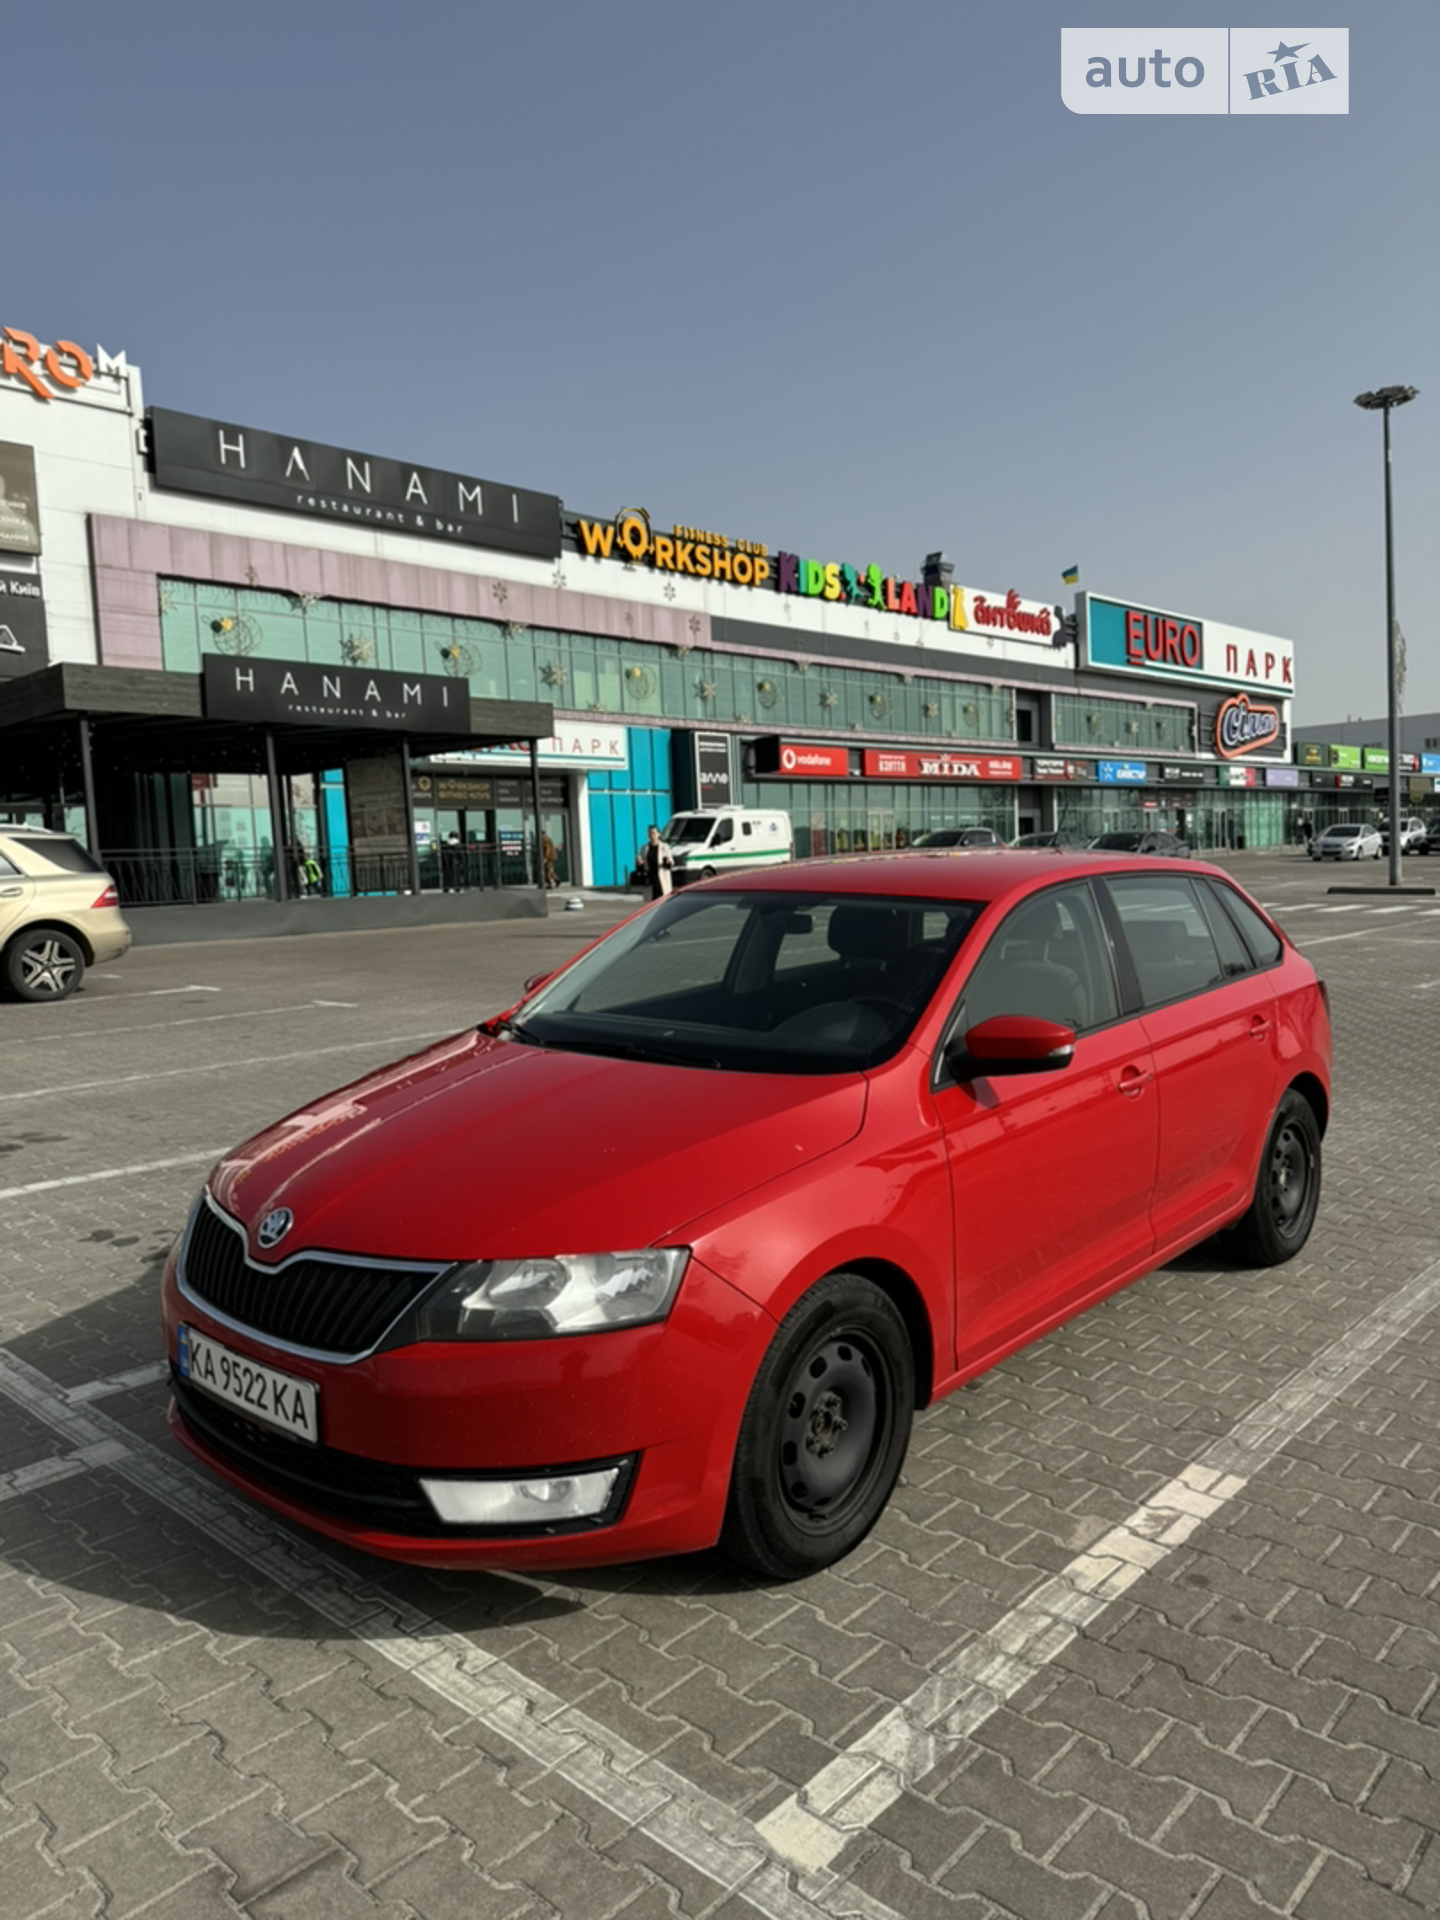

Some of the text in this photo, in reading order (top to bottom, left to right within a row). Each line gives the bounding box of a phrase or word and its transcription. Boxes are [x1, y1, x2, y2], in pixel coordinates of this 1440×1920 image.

[218, 429, 518, 523] HANAMI
[296, 494, 463, 534] restaurant & bar
[579, 516, 770, 588] WORKSHOP
[672, 524, 729, 548] FITNESS
[778, 551, 841, 600] KIDS
[1126, 610, 1292, 684] EURO ПАРК
[235, 667, 448, 707] HANAMI
[288, 703, 407, 720] restaurant & bar
[552, 736, 619, 756] ПАРК
[797, 755, 832, 767] vodafone
[189, 1338, 309, 1430] KA 9522 KA
